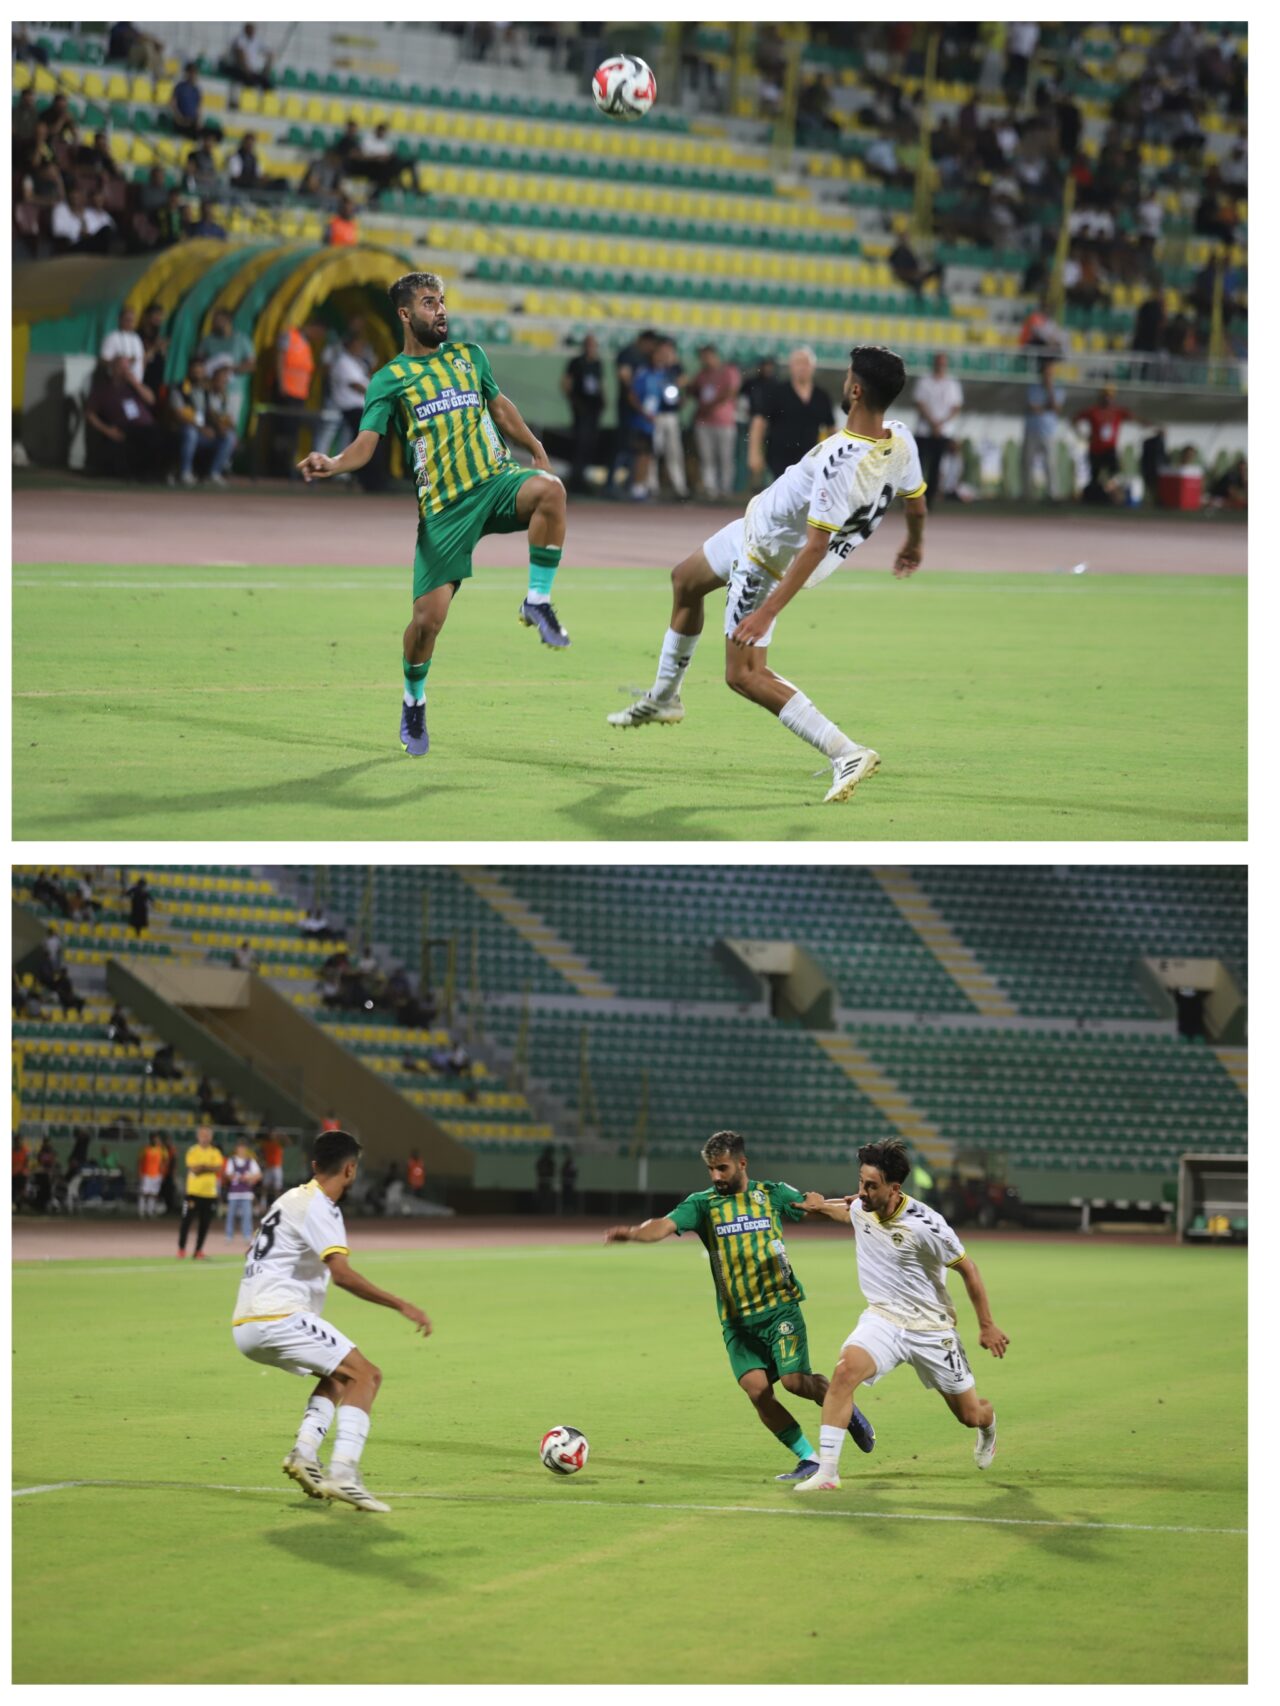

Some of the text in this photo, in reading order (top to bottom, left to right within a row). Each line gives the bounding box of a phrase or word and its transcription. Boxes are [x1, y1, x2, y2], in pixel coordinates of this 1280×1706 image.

[416, 399, 451, 418] ENVER
[716, 1224, 742, 1235] ENVER
[779, 1335, 798, 1358] 17
